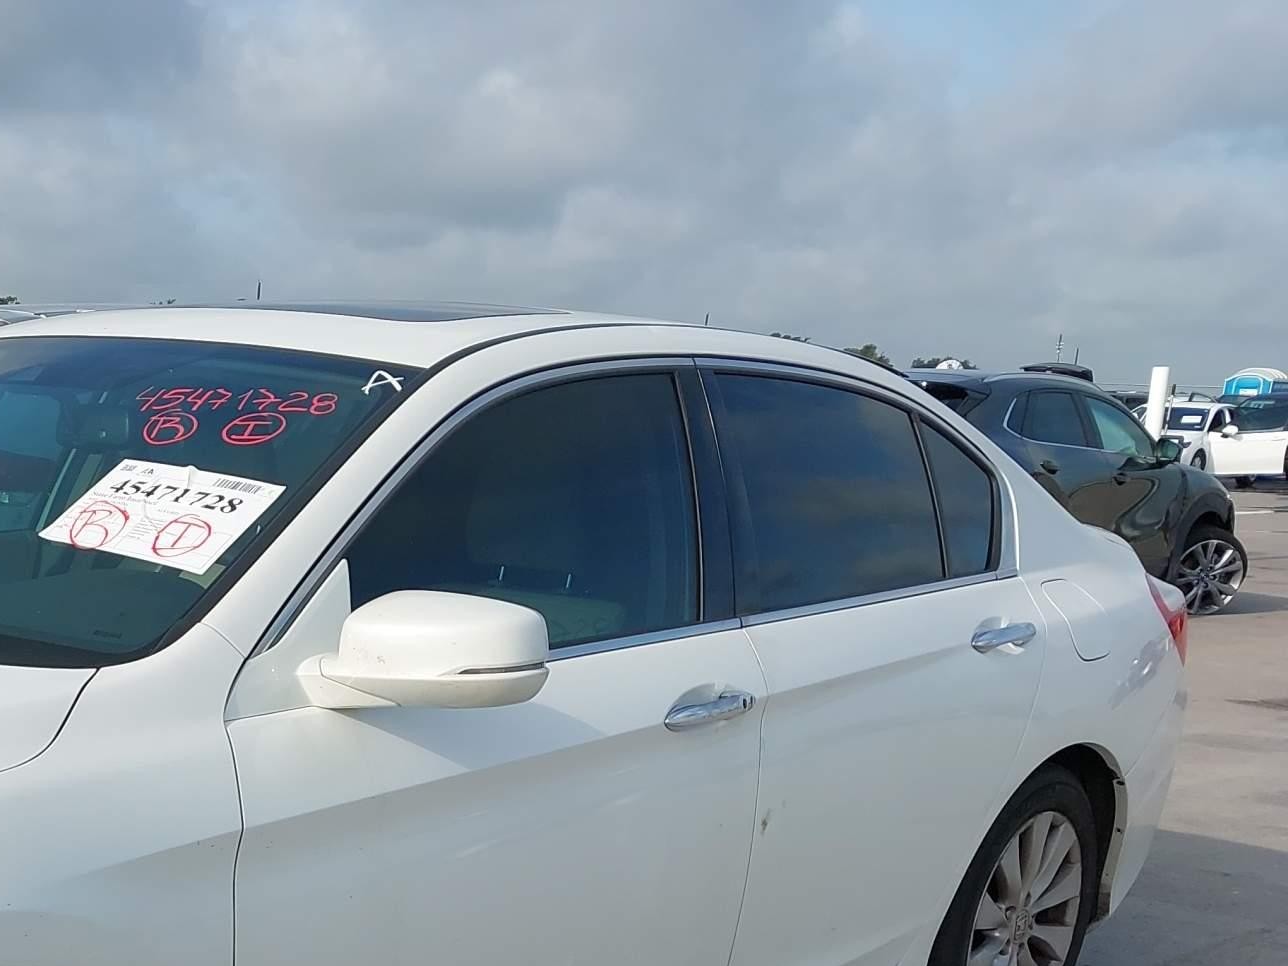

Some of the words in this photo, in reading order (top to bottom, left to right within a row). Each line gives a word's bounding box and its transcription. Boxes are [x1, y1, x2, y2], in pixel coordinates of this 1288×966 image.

[362, 370, 405, 396] A
[135, 386, 339, 415] 45471728
[110, 479, 244, 514] 45471728
